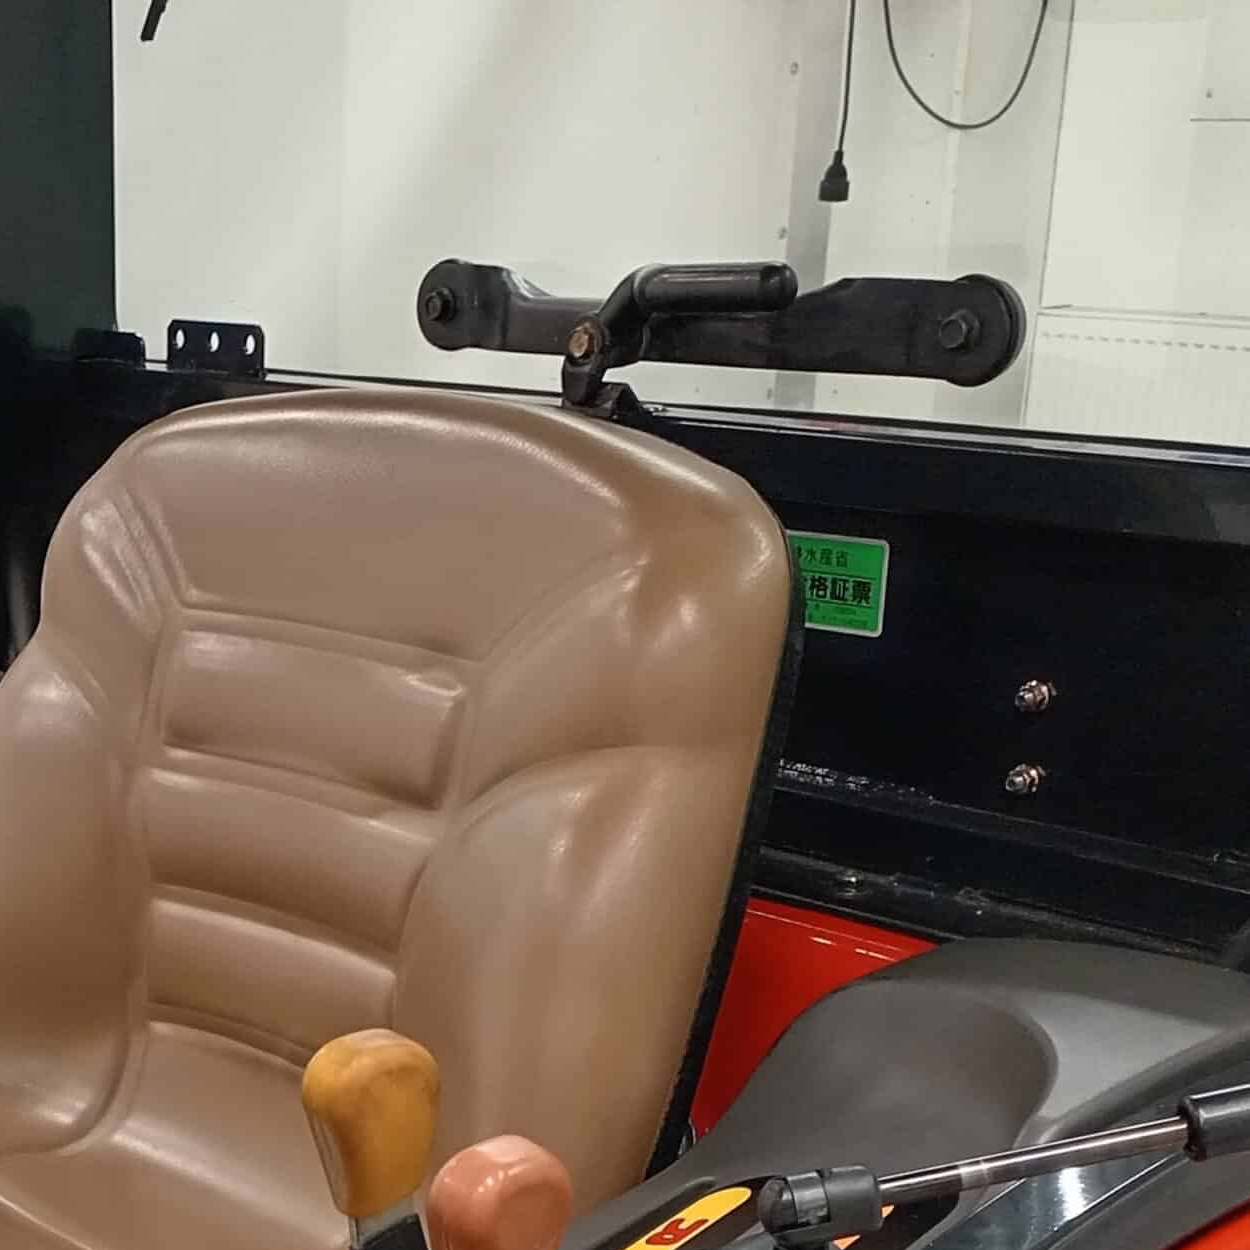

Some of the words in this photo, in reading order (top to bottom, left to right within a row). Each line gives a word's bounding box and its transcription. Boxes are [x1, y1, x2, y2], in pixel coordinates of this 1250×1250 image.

[803, 575, 872, 605] 格証票
[645, 1218, 709, 1245] R
